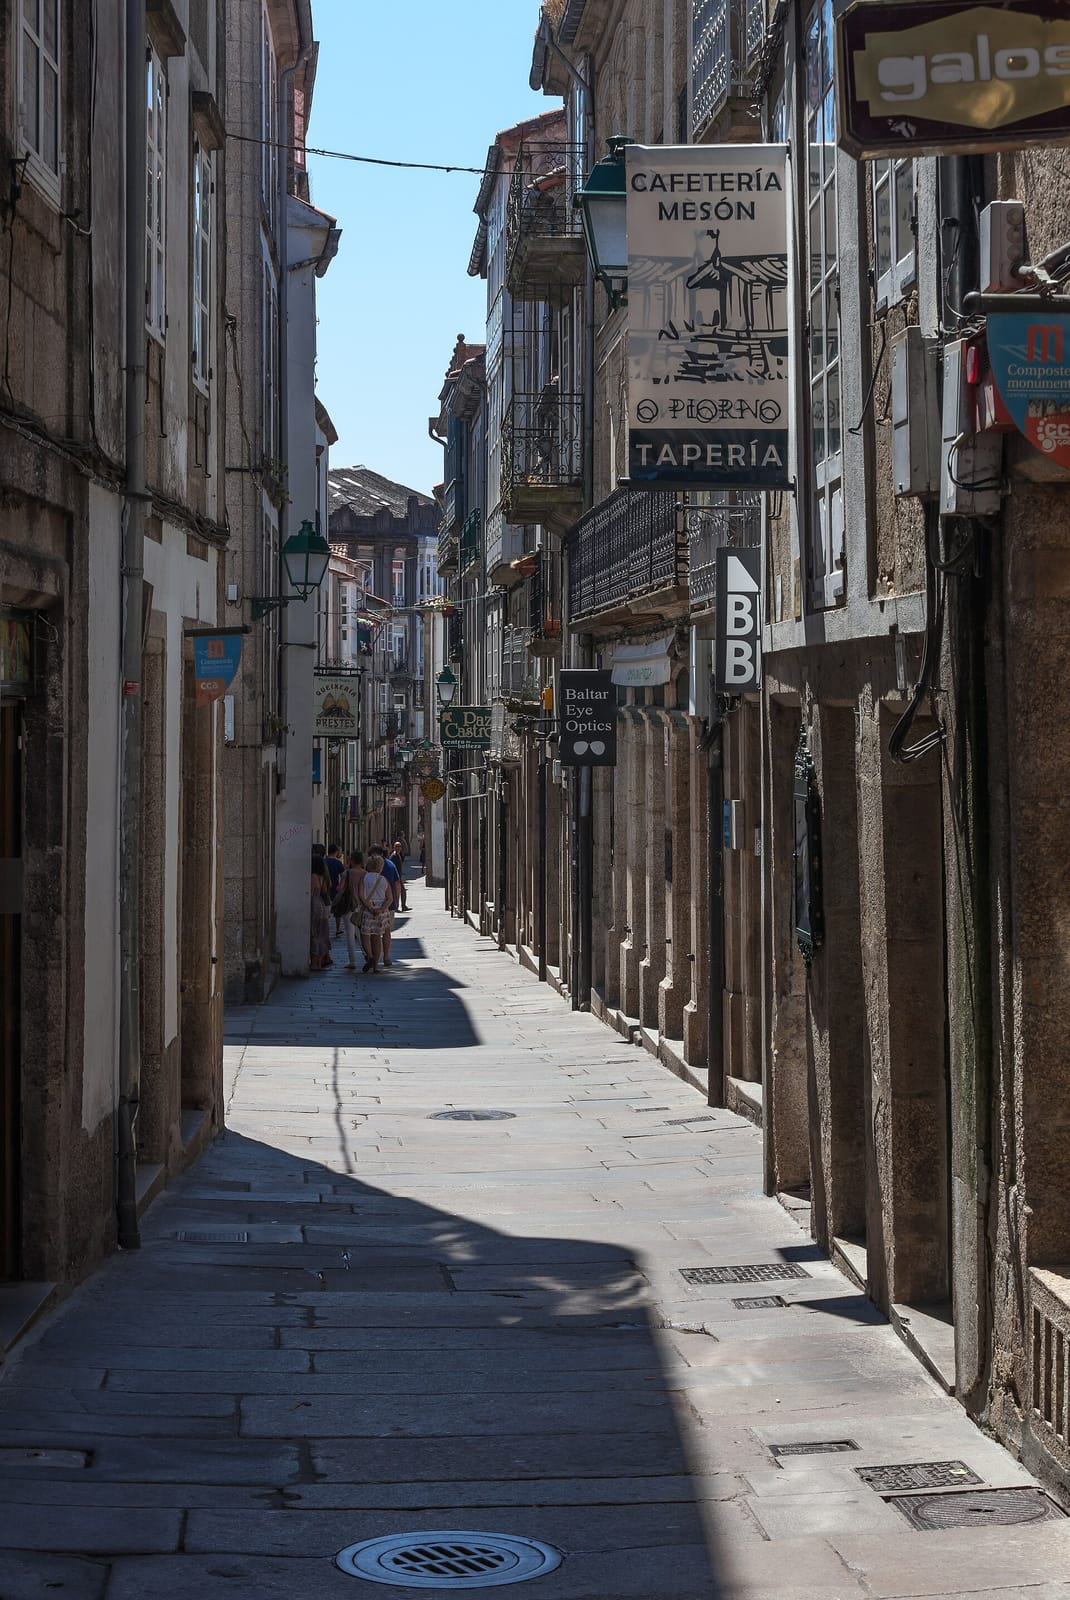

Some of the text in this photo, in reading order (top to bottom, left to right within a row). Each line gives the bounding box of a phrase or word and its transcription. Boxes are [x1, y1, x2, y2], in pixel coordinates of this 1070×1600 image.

[631, 168, 783, 193] CAFETERÍA
[658, 197, 755, 221] MESÓN
[637, 399, 781, 424] O PIORNO
[635, 439, 783, 467] TAPERÍA
[566, 688, 609, 700] Baltar
[463, 711, 492, 727] Paz
[566, 705, 593, 718] Eye
[316, 718, 355, 728] PRESTES
[445, 723, 492, 738] Castro
[566, 720, 612, 734] Optics
